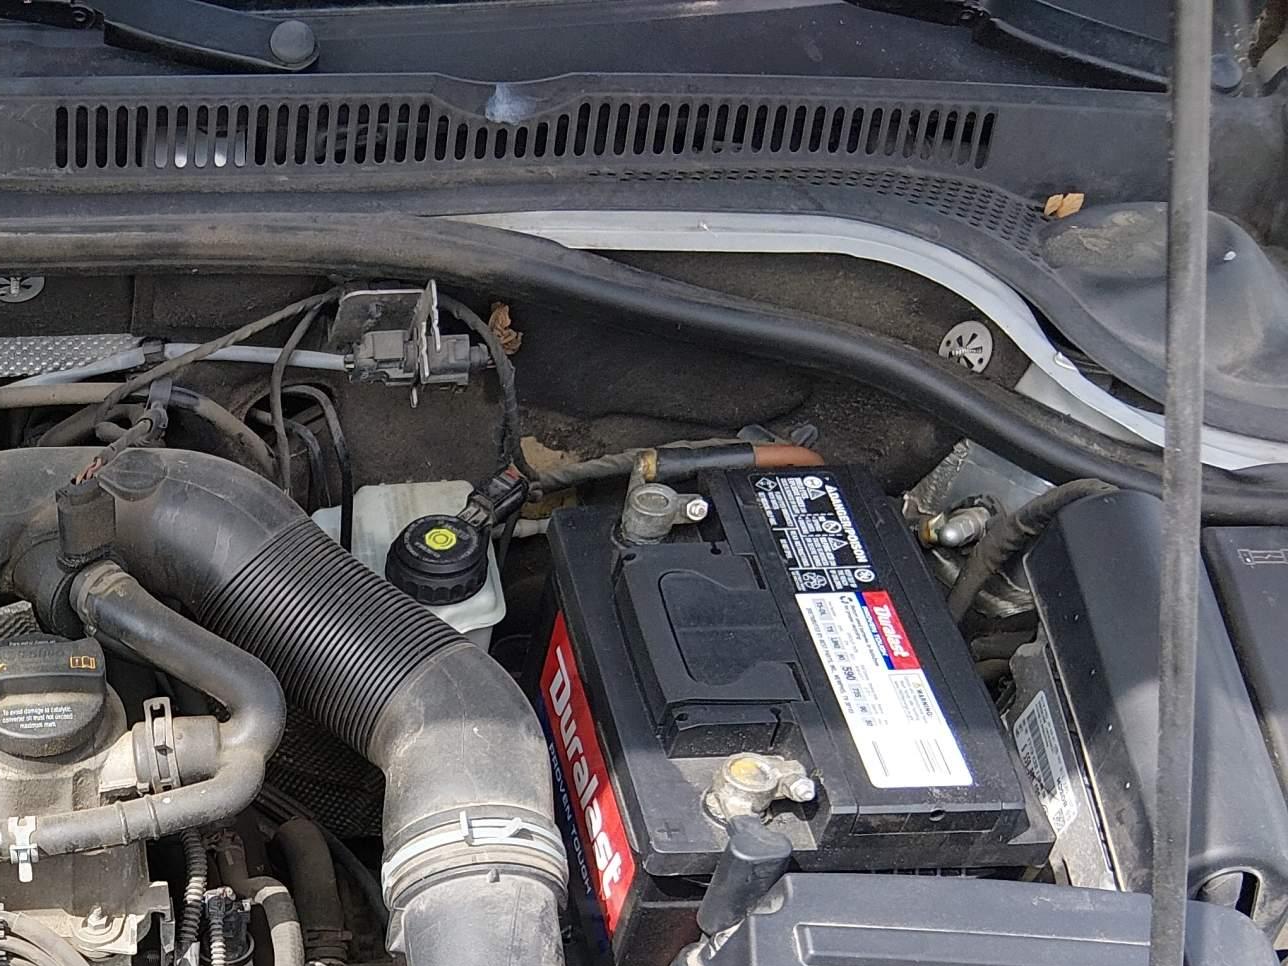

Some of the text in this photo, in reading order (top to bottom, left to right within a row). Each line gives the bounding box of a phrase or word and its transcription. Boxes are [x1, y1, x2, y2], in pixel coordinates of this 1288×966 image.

[827, 494, 868, 561] DANGER/POISON
[872, 604, 910, 658] Duralast
[841, 667, 856, 680] 590
[549, 646, 621, 899] Duralast
[549, 743, 592, 893] PROVEN TOUGH
